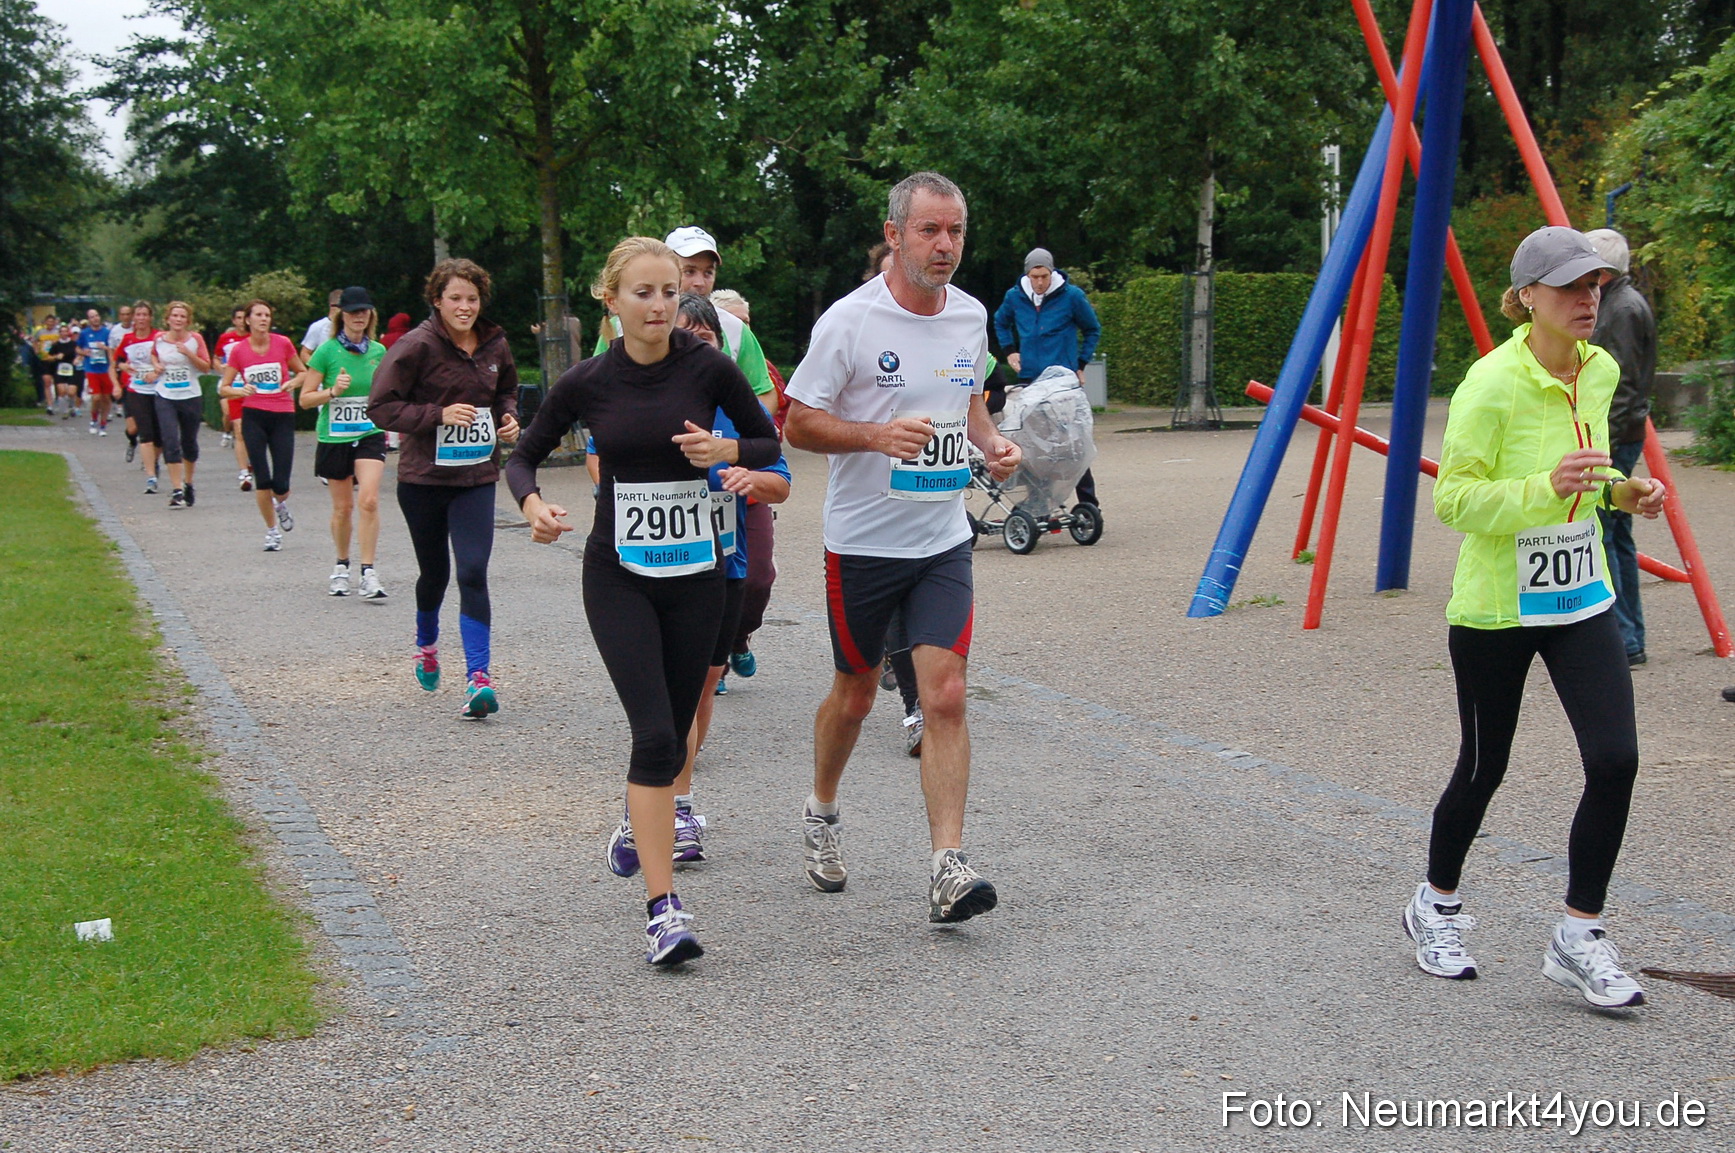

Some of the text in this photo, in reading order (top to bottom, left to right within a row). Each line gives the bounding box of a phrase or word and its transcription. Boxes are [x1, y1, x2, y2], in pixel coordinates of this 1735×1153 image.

[249, 370, 278, 383] 2088
[876, 374, 905, 383] PARTL
[444, 422, 490, 443] 2053
[452, 449, 482, 458] Barbara
[901, 432, 964, 467] 902
[915, 475, 957, 488] Thomas
[617, 490, 696, 502] PARTL Neumarkt
[626, 503, 701, 541] 2901
[1518, 529, 1590, 547] PARTL Neumarkt
[644, 549, 690, 563] Natalie
[1528, 541, 1594, 588] 2071
[1557, 595, 1582, 610] Ilona
